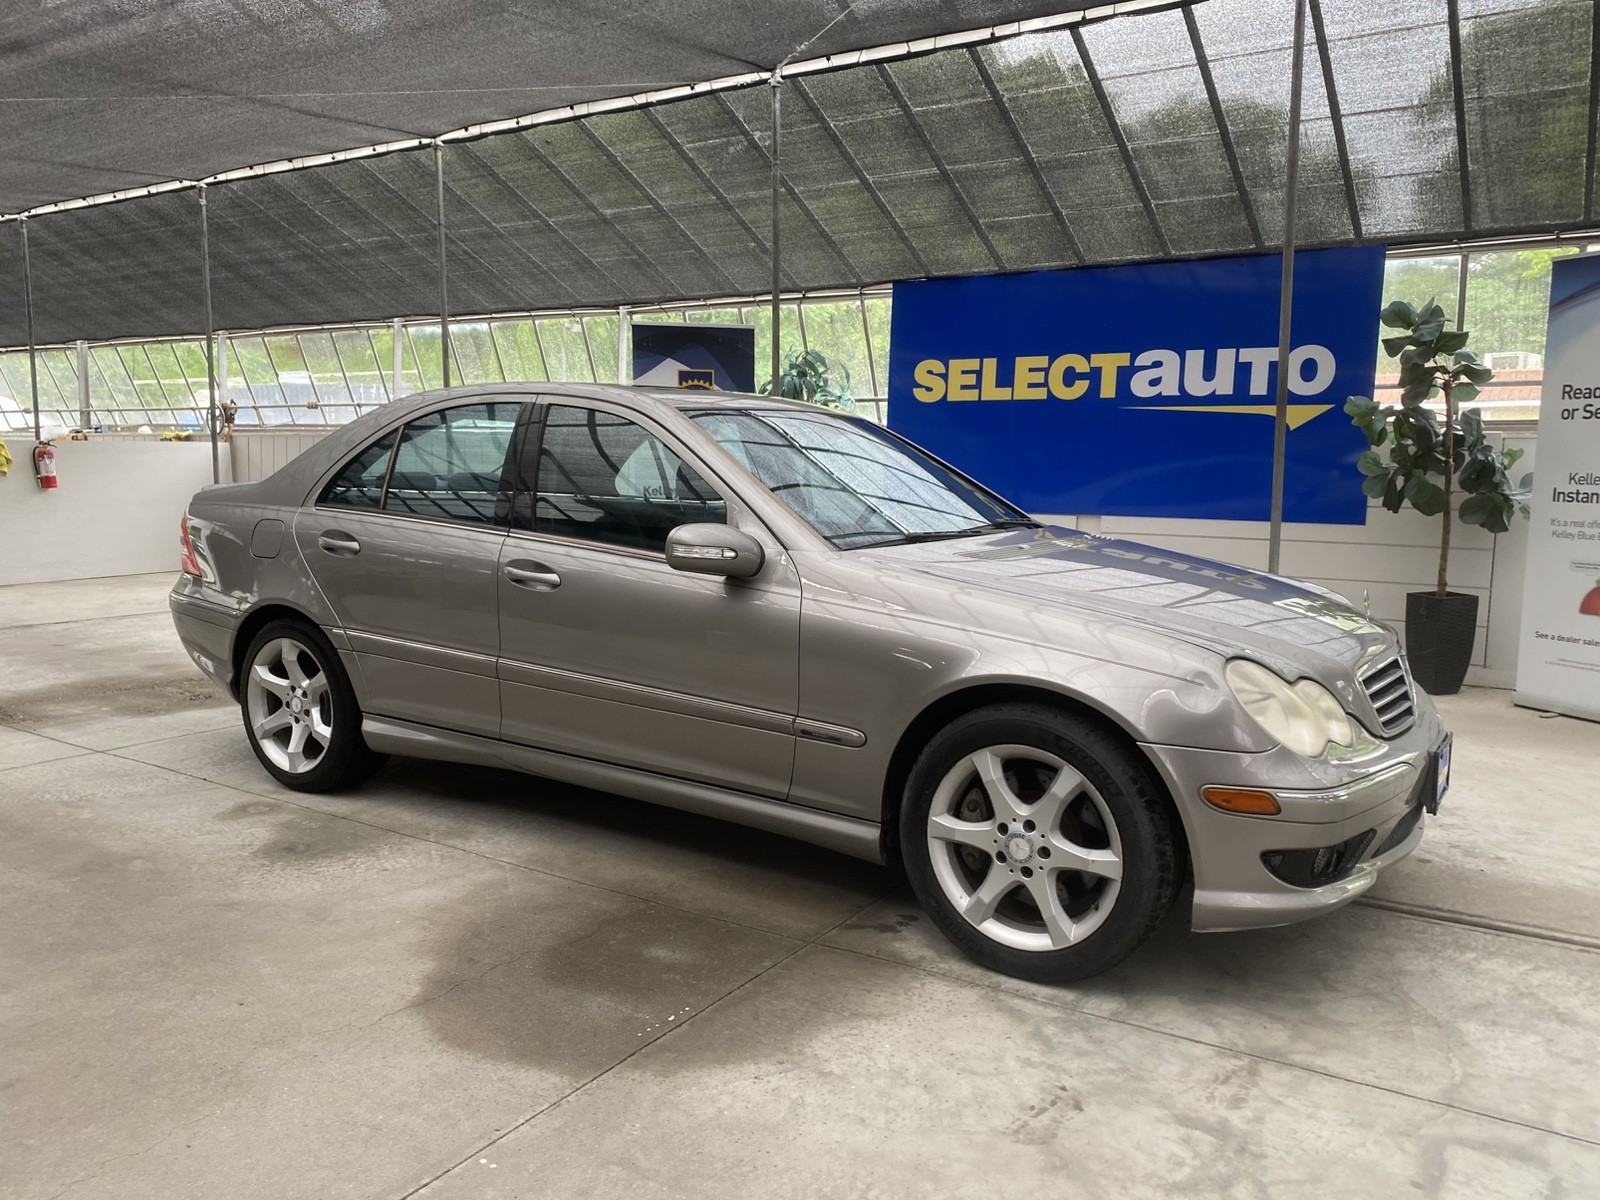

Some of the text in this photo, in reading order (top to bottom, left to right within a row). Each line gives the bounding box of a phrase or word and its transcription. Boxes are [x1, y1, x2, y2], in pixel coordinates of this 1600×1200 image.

[1560, 408, 1580, 420] or
[1552, 487, 1600, 504] Instan
[1569, 519, 1586, 528] real
[1551, 529, 1576, 541] Kelley
[1577, 530, 1596, 541] Blue
[1534, 630, 1549, 640] See
[1556, 634, 1582, 645] dealer
